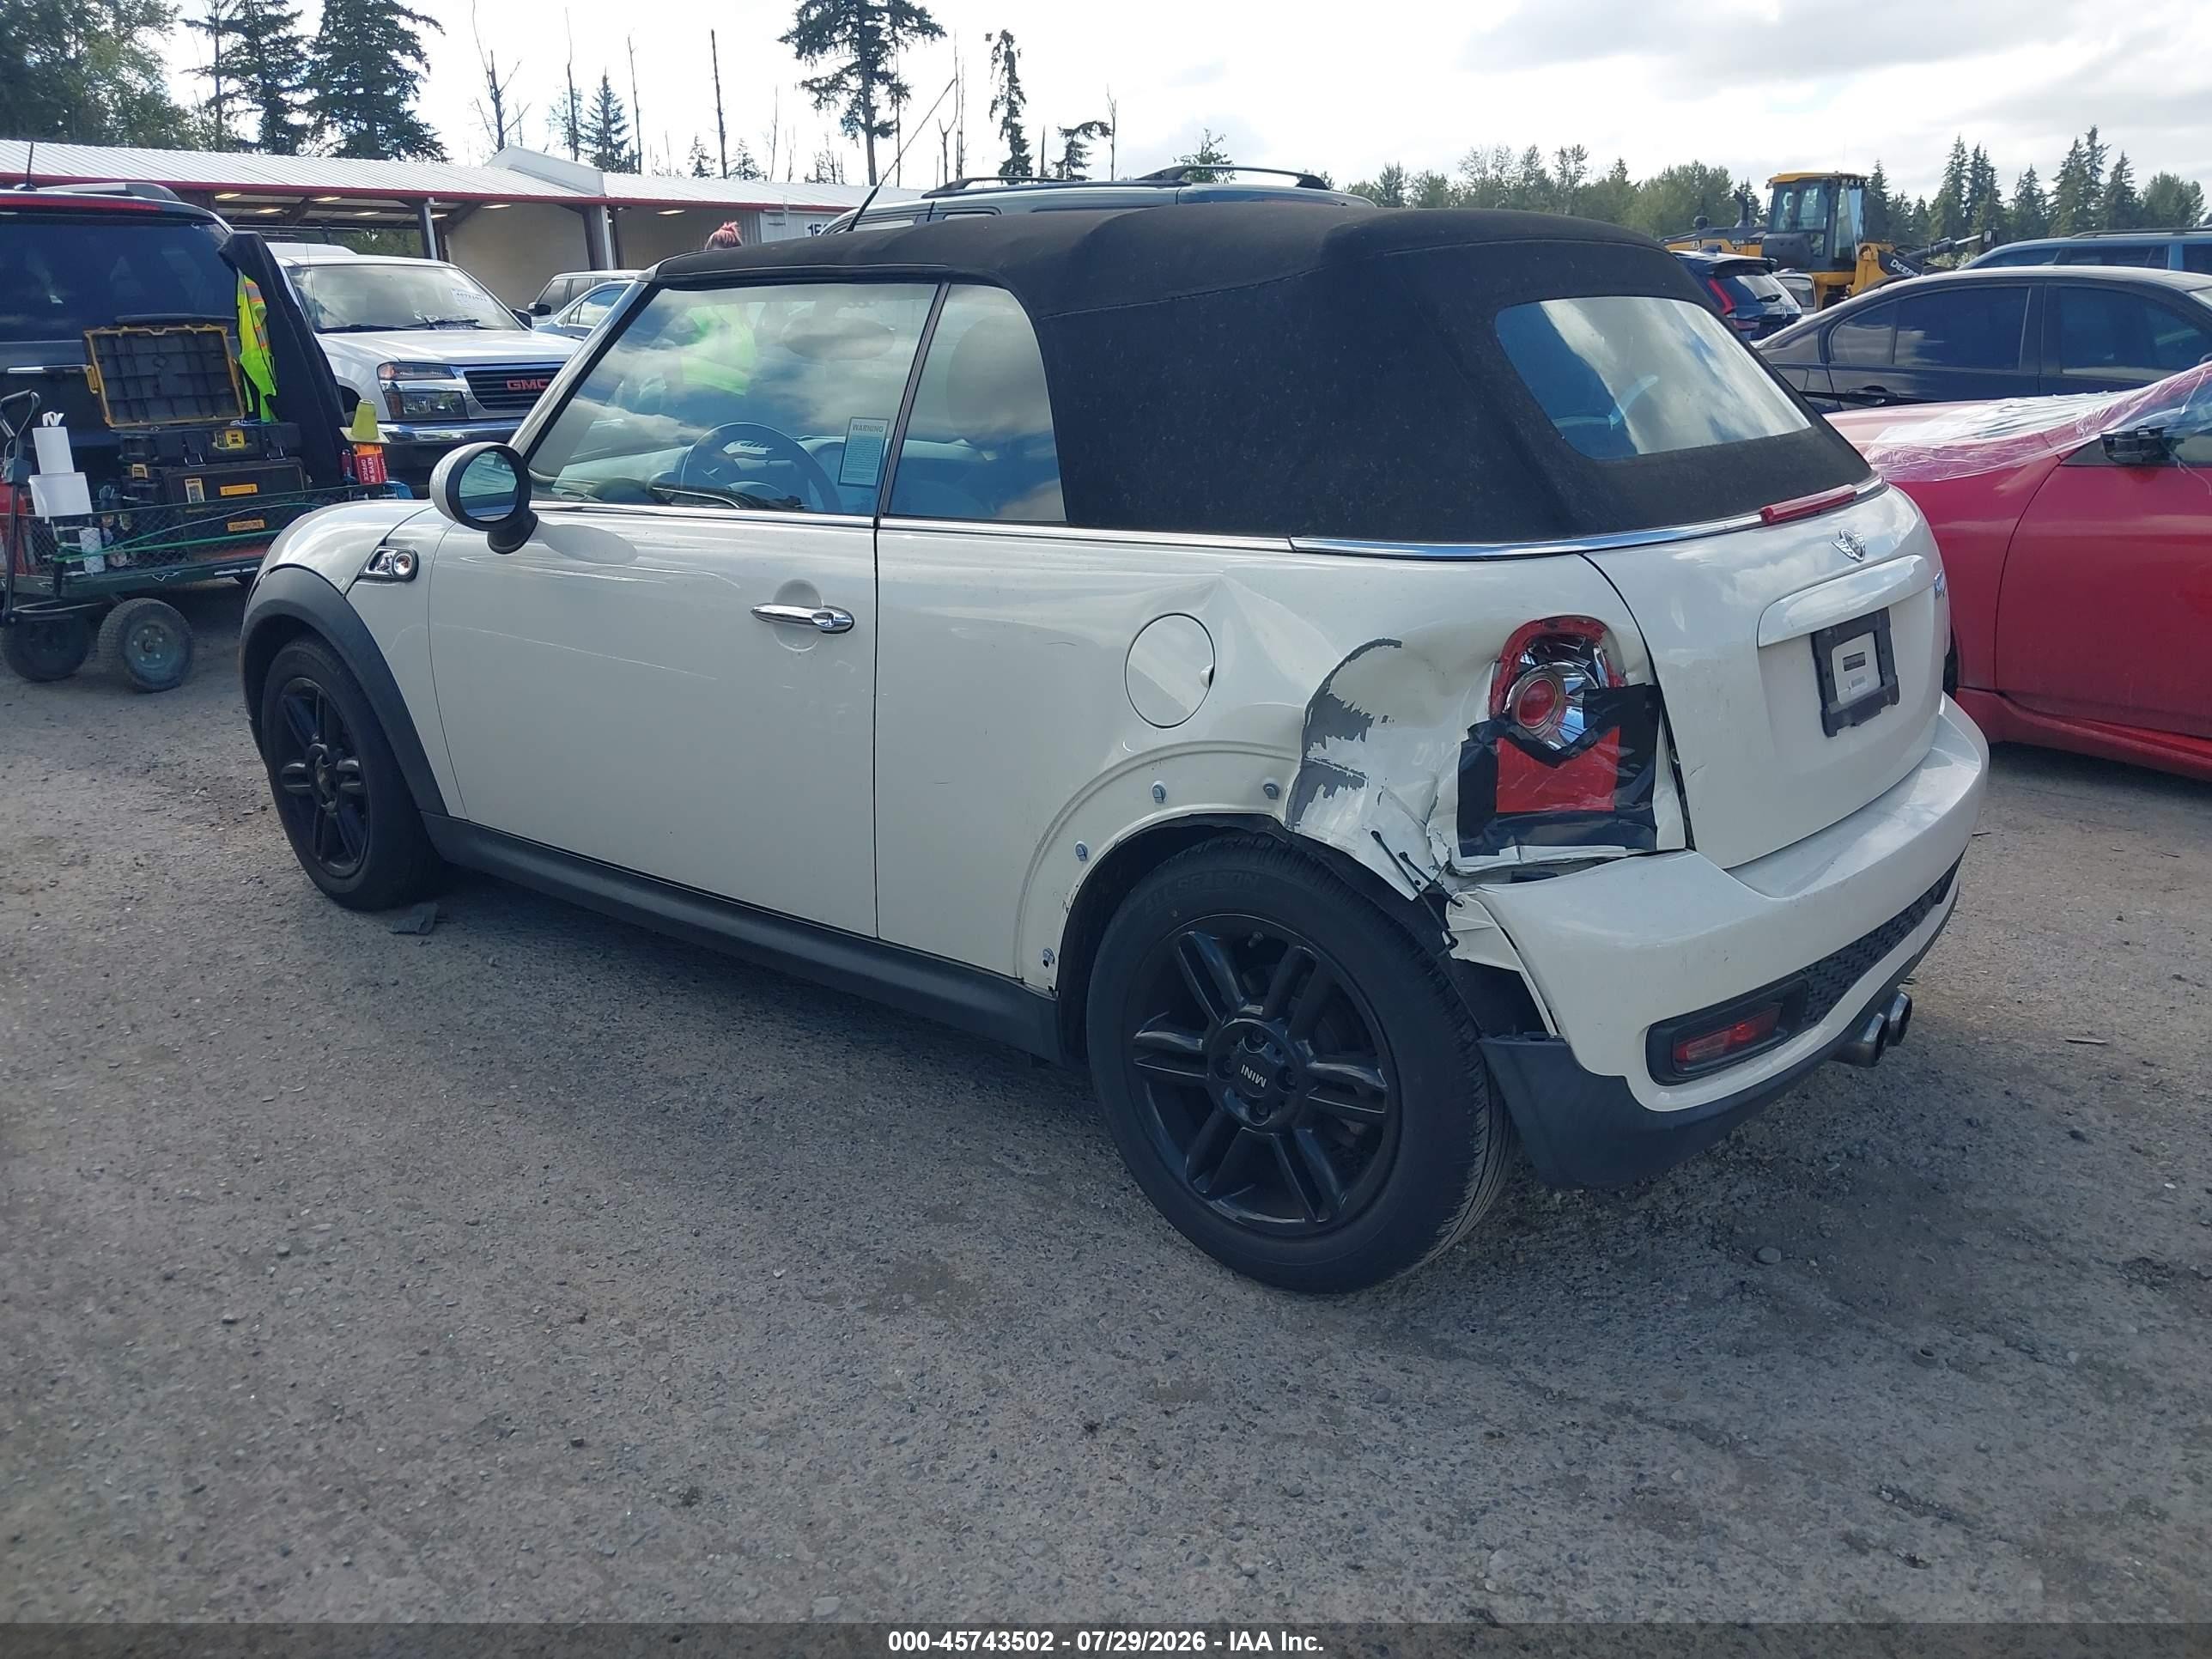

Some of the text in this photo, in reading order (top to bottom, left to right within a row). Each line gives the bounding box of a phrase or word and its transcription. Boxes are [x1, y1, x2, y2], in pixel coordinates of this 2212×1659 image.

[506, 378, 551, 391] GMC
[852, 424, 884, 433] WARNING
[361, 459, 369, 481] OFFICE
[367, 457, 376, 483] KEYS IN
[1240, 1064, 1267, 1088] MINI
